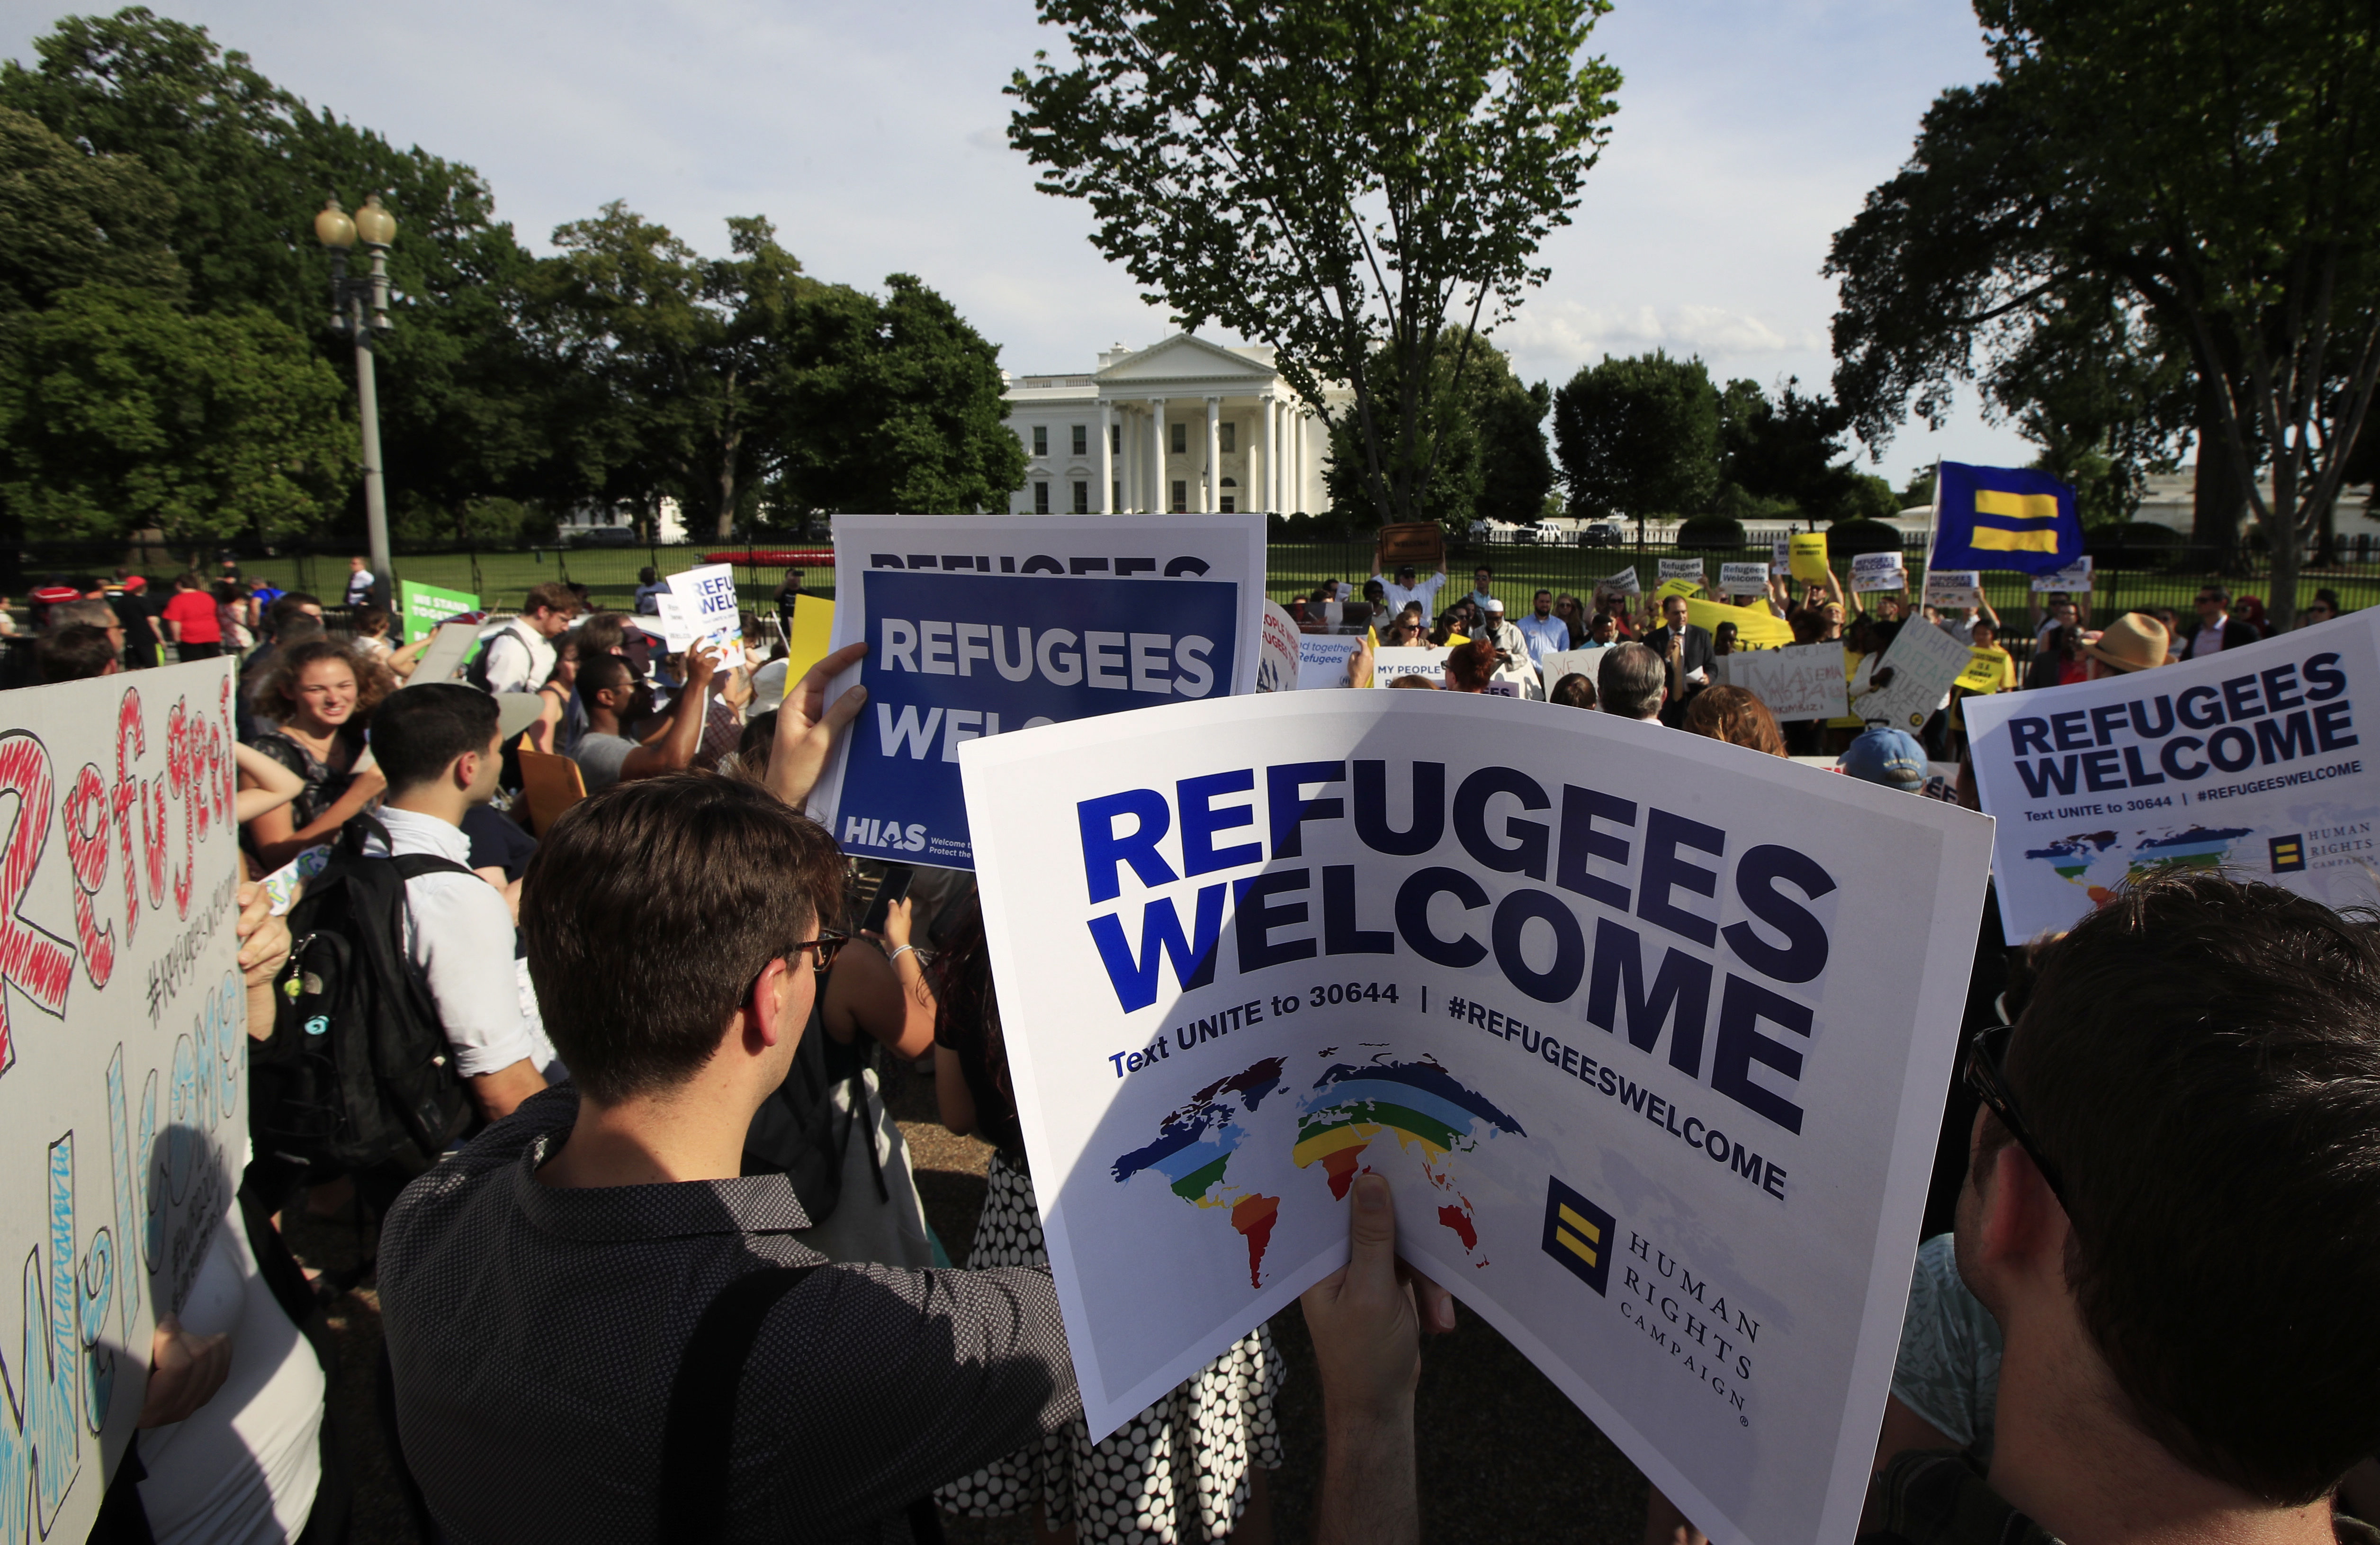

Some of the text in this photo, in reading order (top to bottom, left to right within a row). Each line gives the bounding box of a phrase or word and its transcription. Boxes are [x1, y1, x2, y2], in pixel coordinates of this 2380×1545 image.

[1661, 560, 1701, 571] Refugees
[1724, 565, 1766, 575] Refugees
[1855, 562, 1895, 572] WELCOME
[1856, 557, 1895, 566] REFUGEES
[1661, 570, 1701, 578] Welcome
[1723, 574, 1765, 582] Welcome
[692, 576, 734, 596] REFU
[432, 597, 470, 613] STAND
[1264, 614, 1285, 638] OPLE
[1312, 643, 1353, 653] together
[1907, 616, 1970, 670] NO HATE
[880, 618, 1215, 698] REFUGEES
[1300, 652, 1343, 665] Refugees
[1549, 657, 1574, 676] WE
[1378, 665, 1441, 674] MY PEOPLE
[2008, 652, 2347, 756] REFUGEES
[2014, 700, 2359, 799] WELCOME
[2025, 809, 2055, 822] Text
[2058, 804, 2103, 819] UNITE
[2107, 802, 2123, 813] to
[2127, 795, 2172, 811] 30644
[2197, 759, 2362, 802] #REFUGEESWELCOME
[844, 816, 927, 852] HIAS
[2308, 822, 2371, 840] HUMAN
[929, 846, 957, 857] Protect
[931, 837, 965, 848] Welcome
[2310, 839, 2372, 856] RIGHTS
[1076, 759, 1838, 984] REFUGEES
[1086, 864, 1814, 1137] WELCOME
[1109, 1035, 1169, 1079] Text
[1177, 999, 1264, 1051] UNITE
[1271, 995, 1300, 1017] to
[1310, 982, 1399, 1008] 30644
[1448, 995, 1787, 1202] #REFUGEESWELCOME
[1628, 1230, 1760, 1344] HUMAN
[1624, 1265, 1751, 1380] RIGHTS
